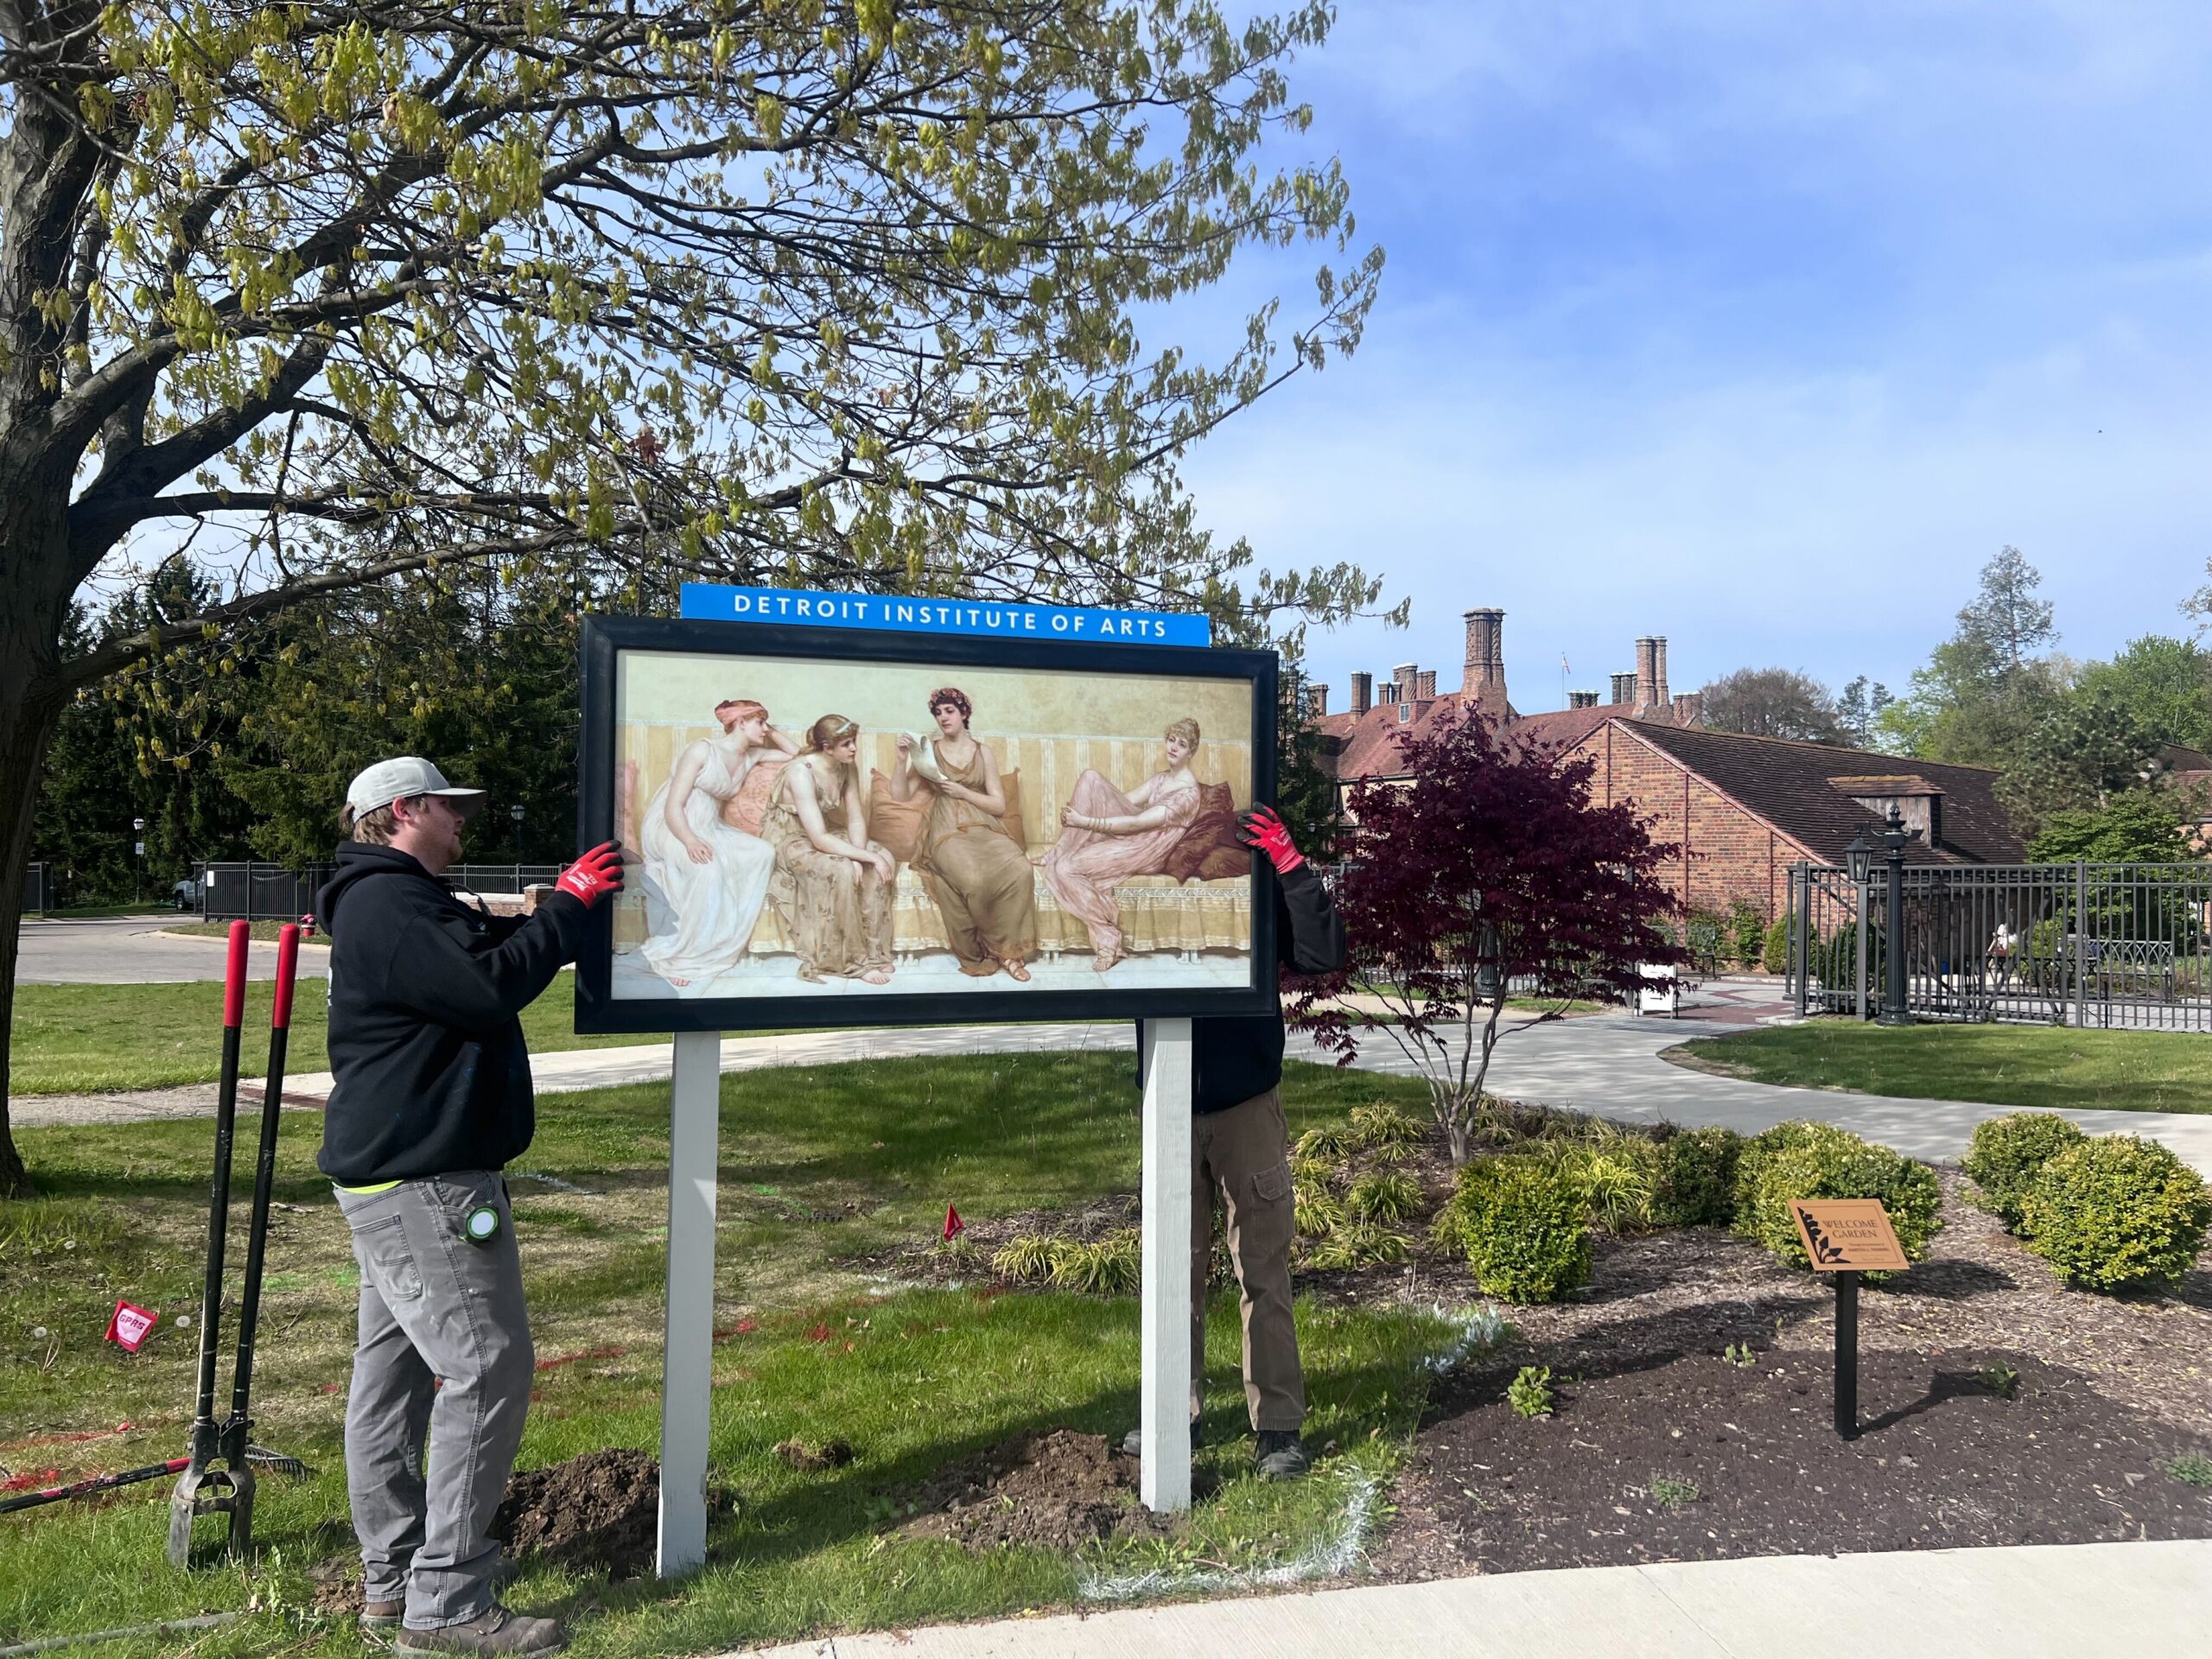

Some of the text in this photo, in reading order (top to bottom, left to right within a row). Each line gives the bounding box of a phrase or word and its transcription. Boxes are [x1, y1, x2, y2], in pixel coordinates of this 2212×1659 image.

[734, 594, 1166, 638] DETROIT INSTITUTE OF ARTS
[1822, 1219, 1878, 1229] WELCOME
[1832, 1230, 1878, 1238] GARDEN
[119, 1313, 146, 1330] GPRS
